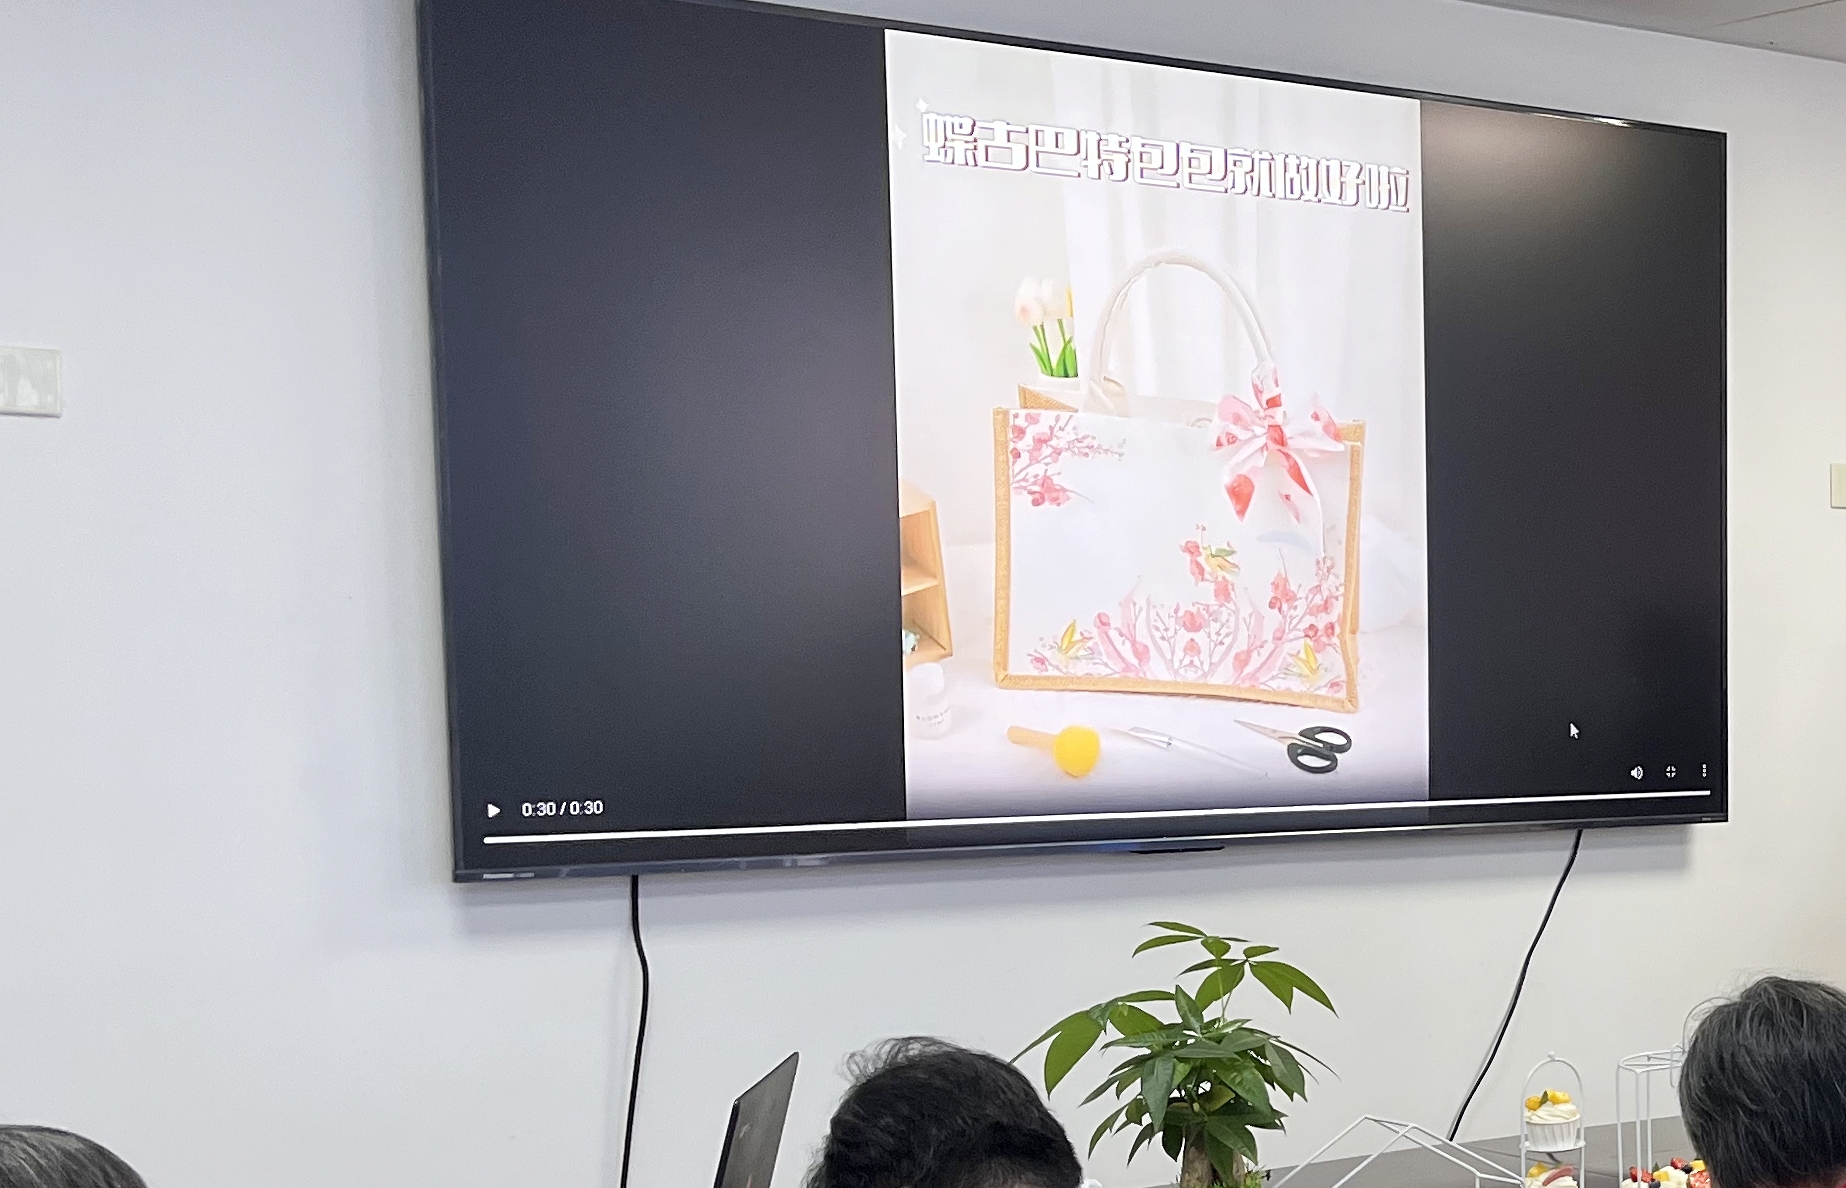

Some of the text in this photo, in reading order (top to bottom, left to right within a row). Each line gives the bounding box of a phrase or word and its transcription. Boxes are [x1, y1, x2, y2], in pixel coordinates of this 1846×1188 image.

[921, 111, 1410, 213] 蝶古巴特包包就做好啦
[521, 802, 557, 817] 0:30
[570, 800, 604, 816] 0:30
